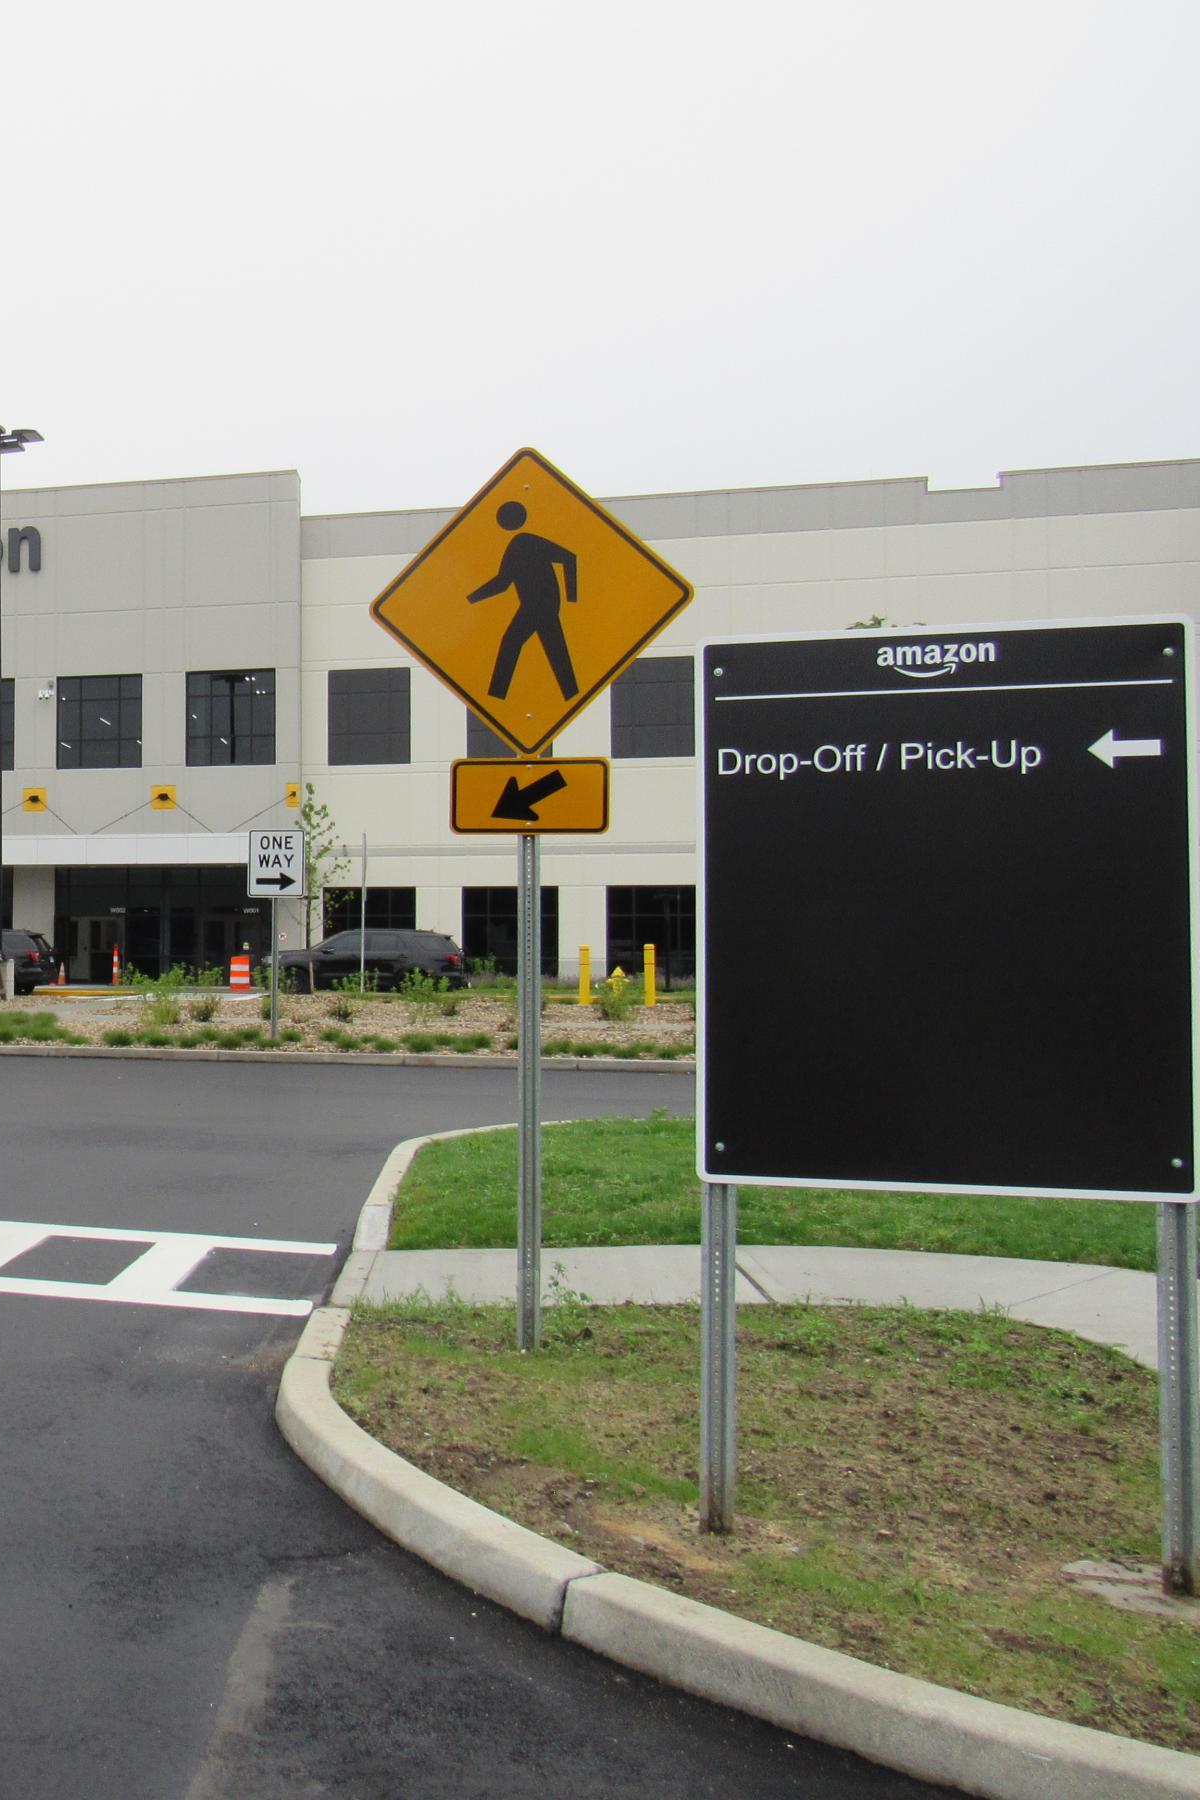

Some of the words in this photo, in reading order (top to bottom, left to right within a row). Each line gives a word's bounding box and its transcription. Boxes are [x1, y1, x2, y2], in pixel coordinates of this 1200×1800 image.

[876, 642, 996, 667] amazon
[717, 744, 868, 781] Drop-Off
[875, 743, 888, 771] /
[900, 739, 1042, 775] Pick-Up
[260, 835, 293, 850] ONE
[258, 854, 295, 868] WAY
